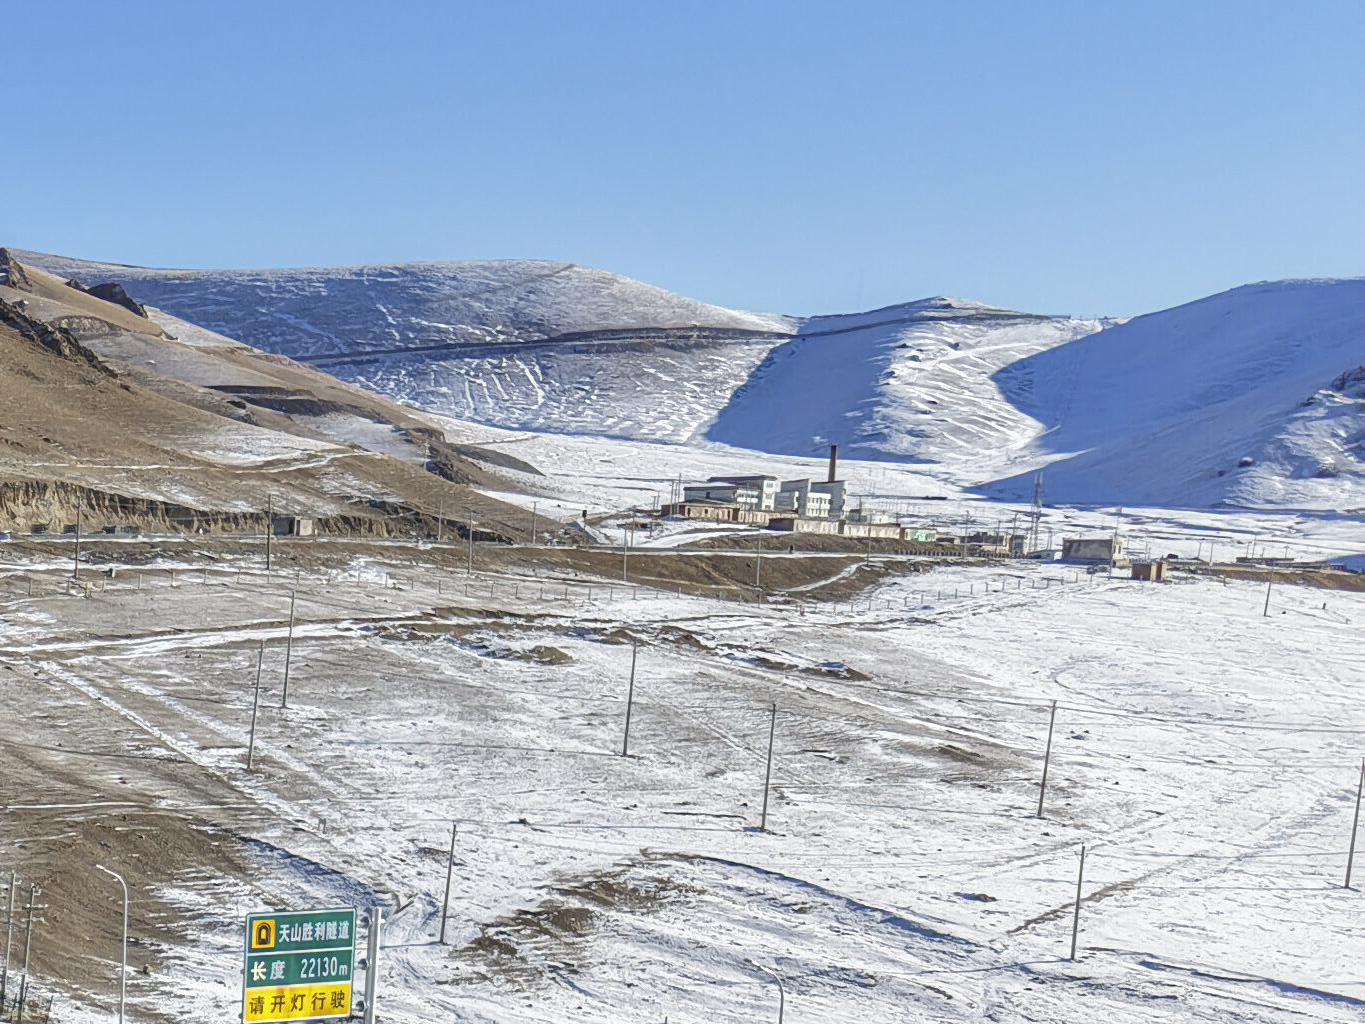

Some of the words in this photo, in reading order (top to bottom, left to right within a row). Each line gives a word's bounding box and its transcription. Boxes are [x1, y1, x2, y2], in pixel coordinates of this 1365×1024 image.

[278, 920, 350, 943] 天山胜利隧道
[251, 960, 286, 981] 长度
[300, 956, 348, 979] 22130m
[249, 990, 345, 1015] 请开灯行驶
